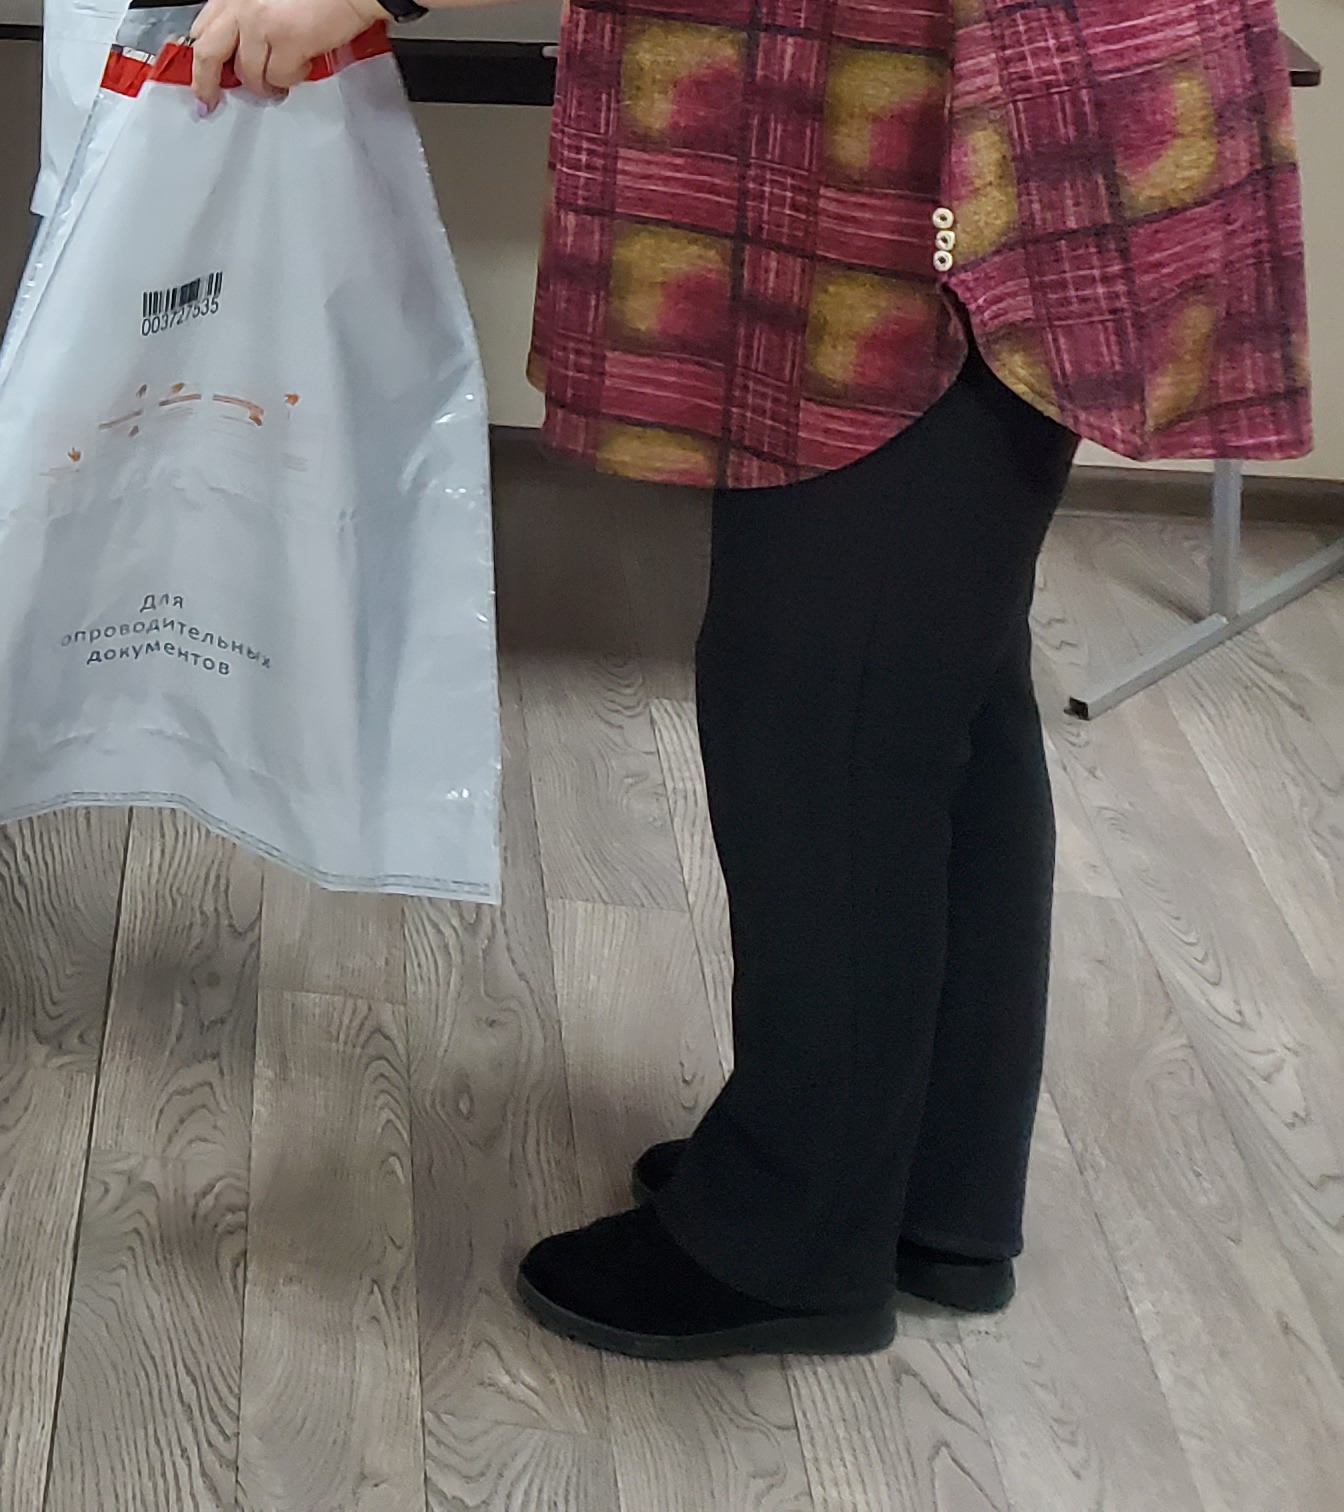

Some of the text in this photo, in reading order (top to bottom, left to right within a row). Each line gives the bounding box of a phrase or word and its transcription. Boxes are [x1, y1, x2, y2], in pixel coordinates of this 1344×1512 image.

[141, 298, 220, 337] 003727535
[139, 592, 184, 613] Для
[85, 639, 230, 676] документов
